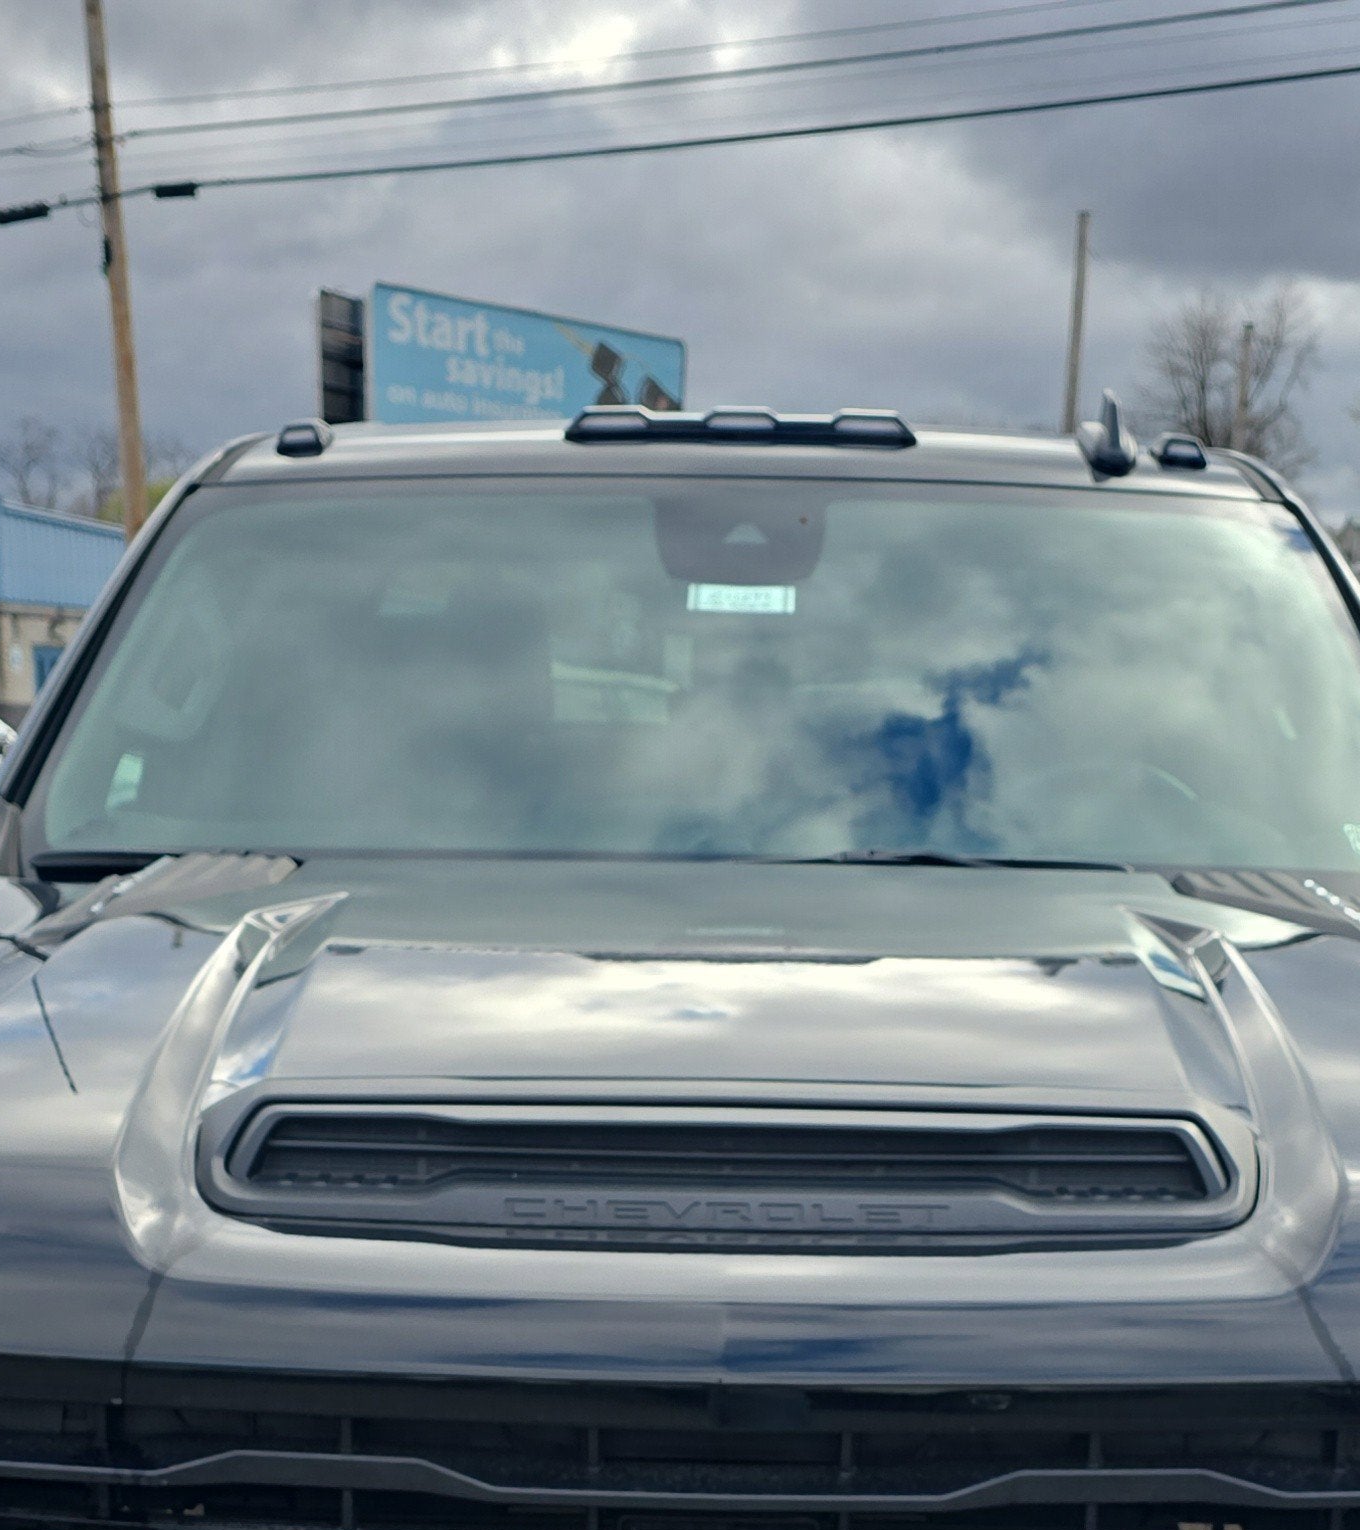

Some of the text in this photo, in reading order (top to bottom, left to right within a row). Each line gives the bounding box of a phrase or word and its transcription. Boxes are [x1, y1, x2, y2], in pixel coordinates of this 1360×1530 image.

[389, 293, 488, 356] Start
[446, 355, 564, 404] savings!
[504, 1197, 949, 1224] CHEVROLET
